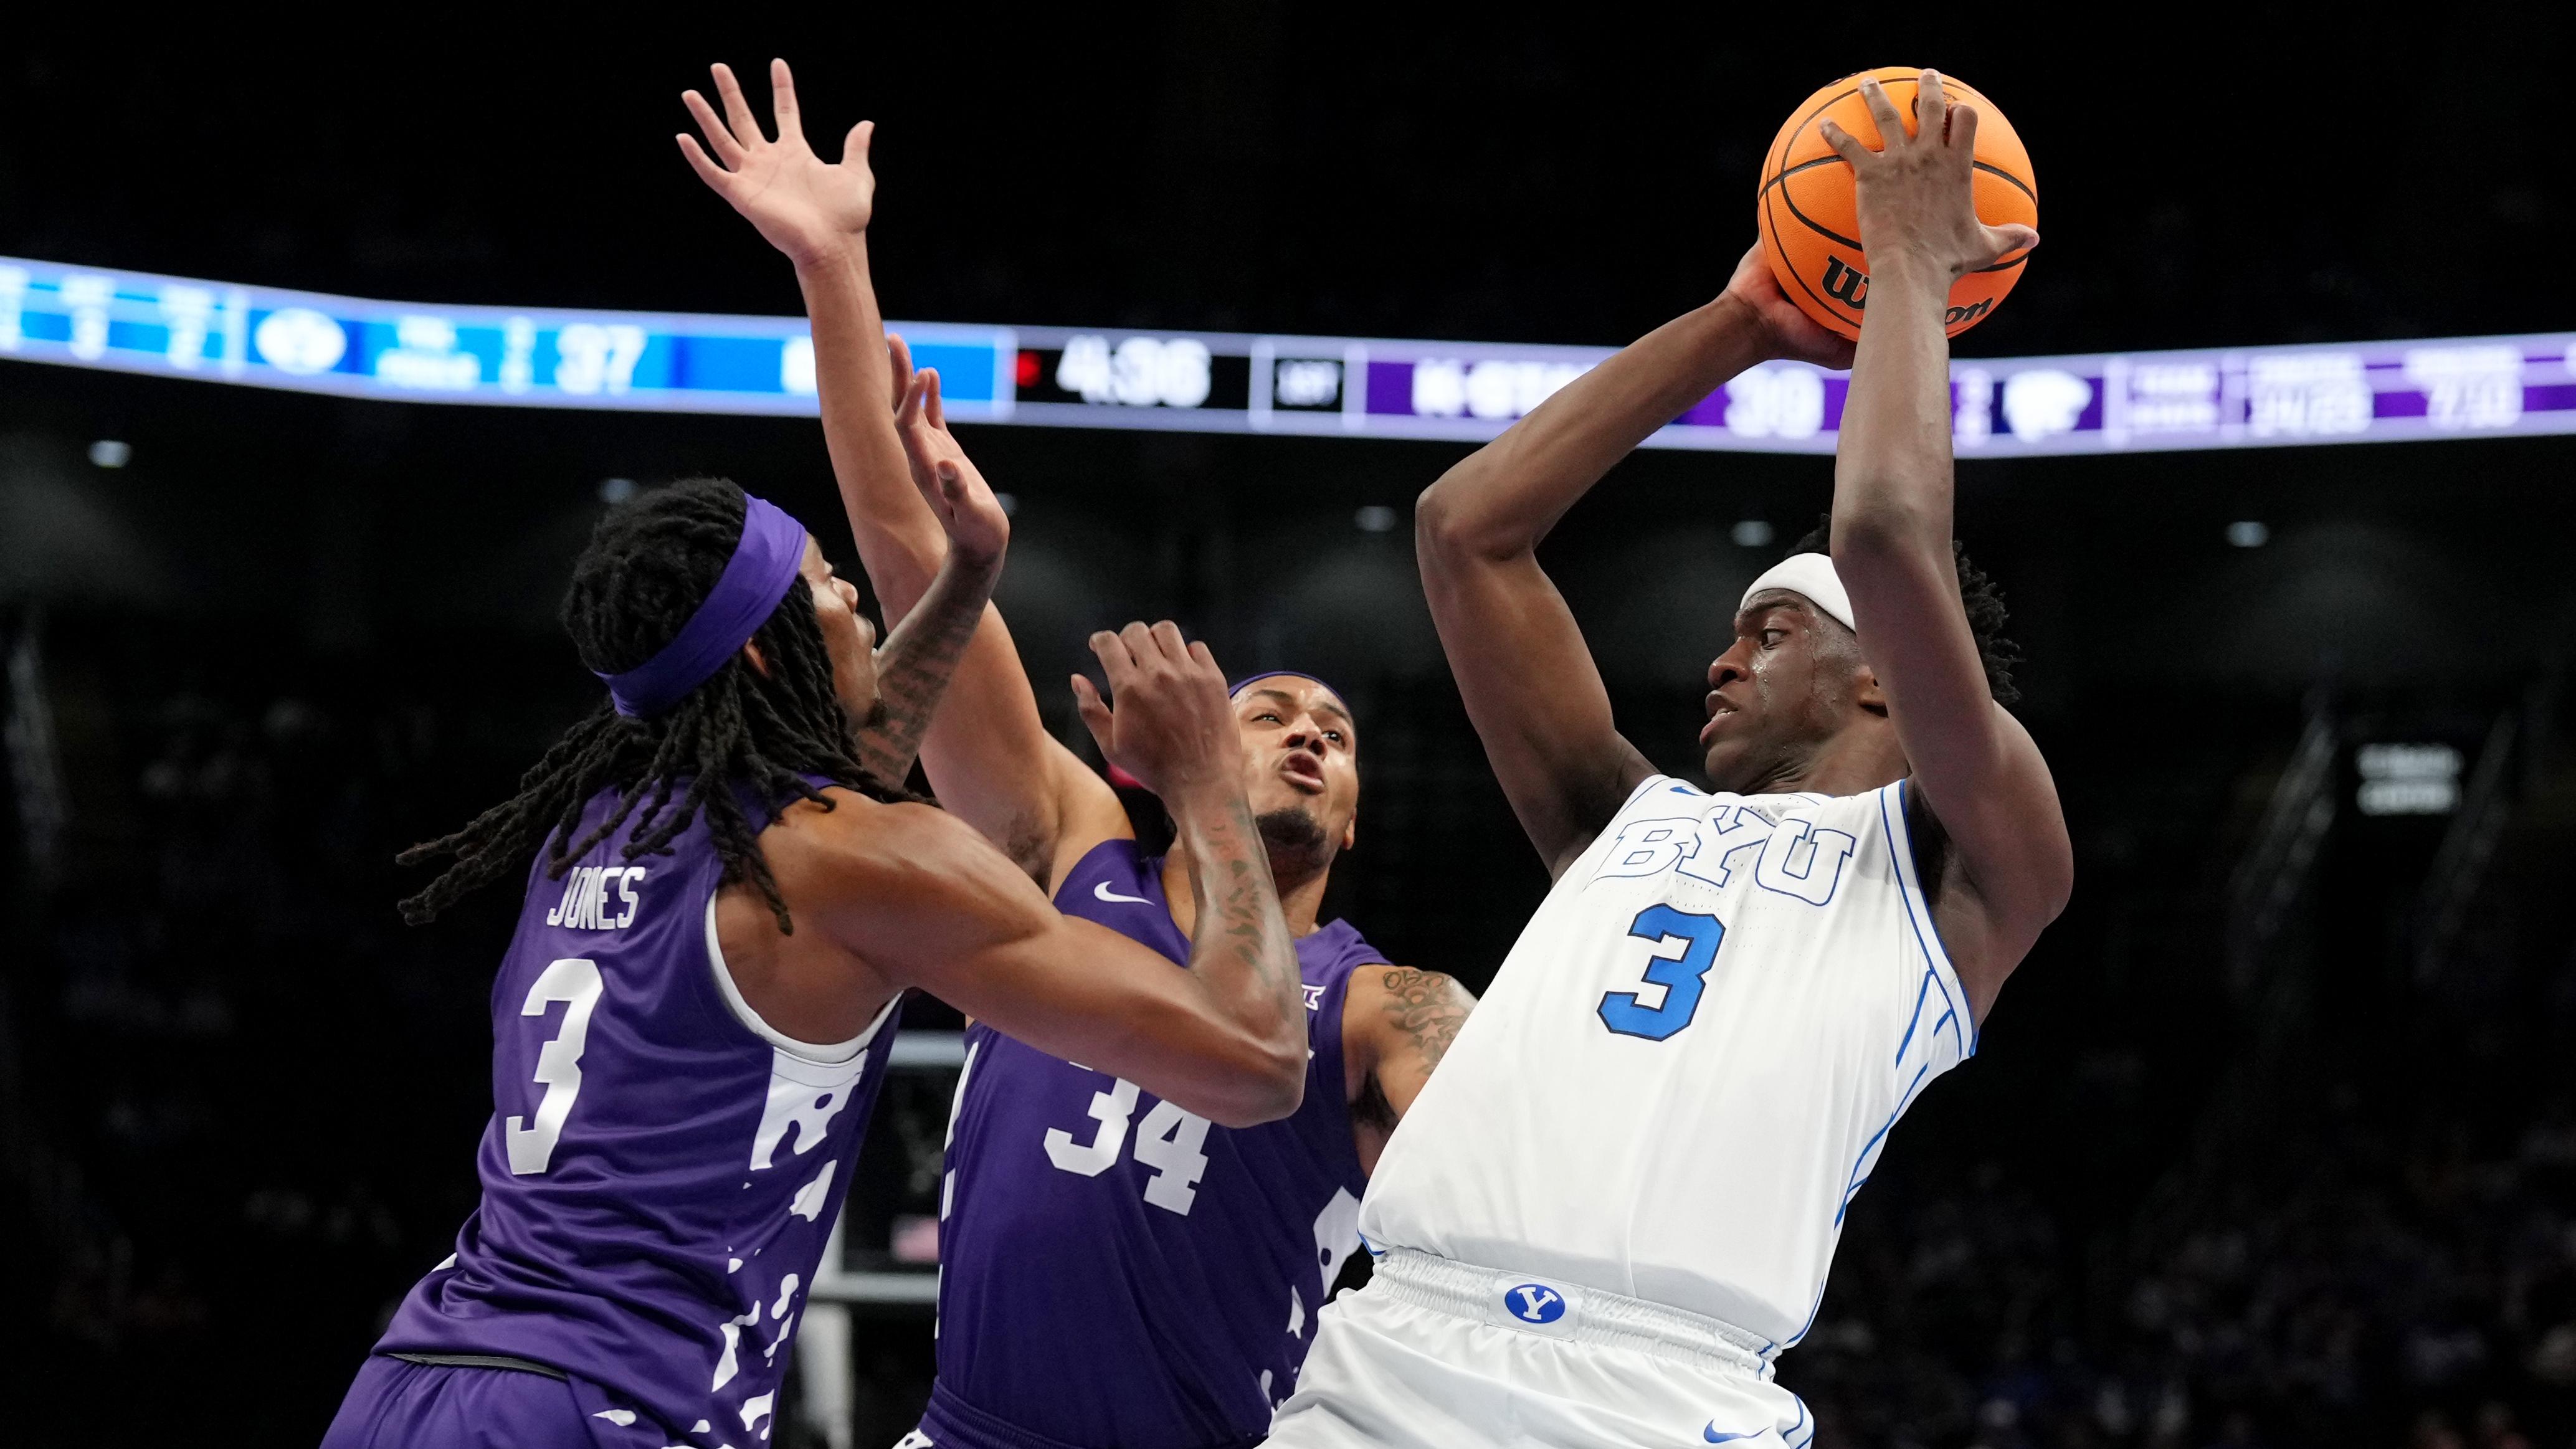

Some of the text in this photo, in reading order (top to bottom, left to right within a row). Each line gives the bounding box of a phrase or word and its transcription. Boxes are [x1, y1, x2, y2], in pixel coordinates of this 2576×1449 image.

[1820, 254, 1994, 326] Won
[556, 323, 647, 394] 37
[1056, 335, 1211, 408] 4:36
[1582, 805, 1856, 906] BYU
[546, 867, 646, 929] JONES
[1597, 902, 1726, 1042] 3
[506, 958, 604, 1175] 3
[1043, 1061, 1209, 1216] 34
[1516, 1286, 1558, 1321] Y
